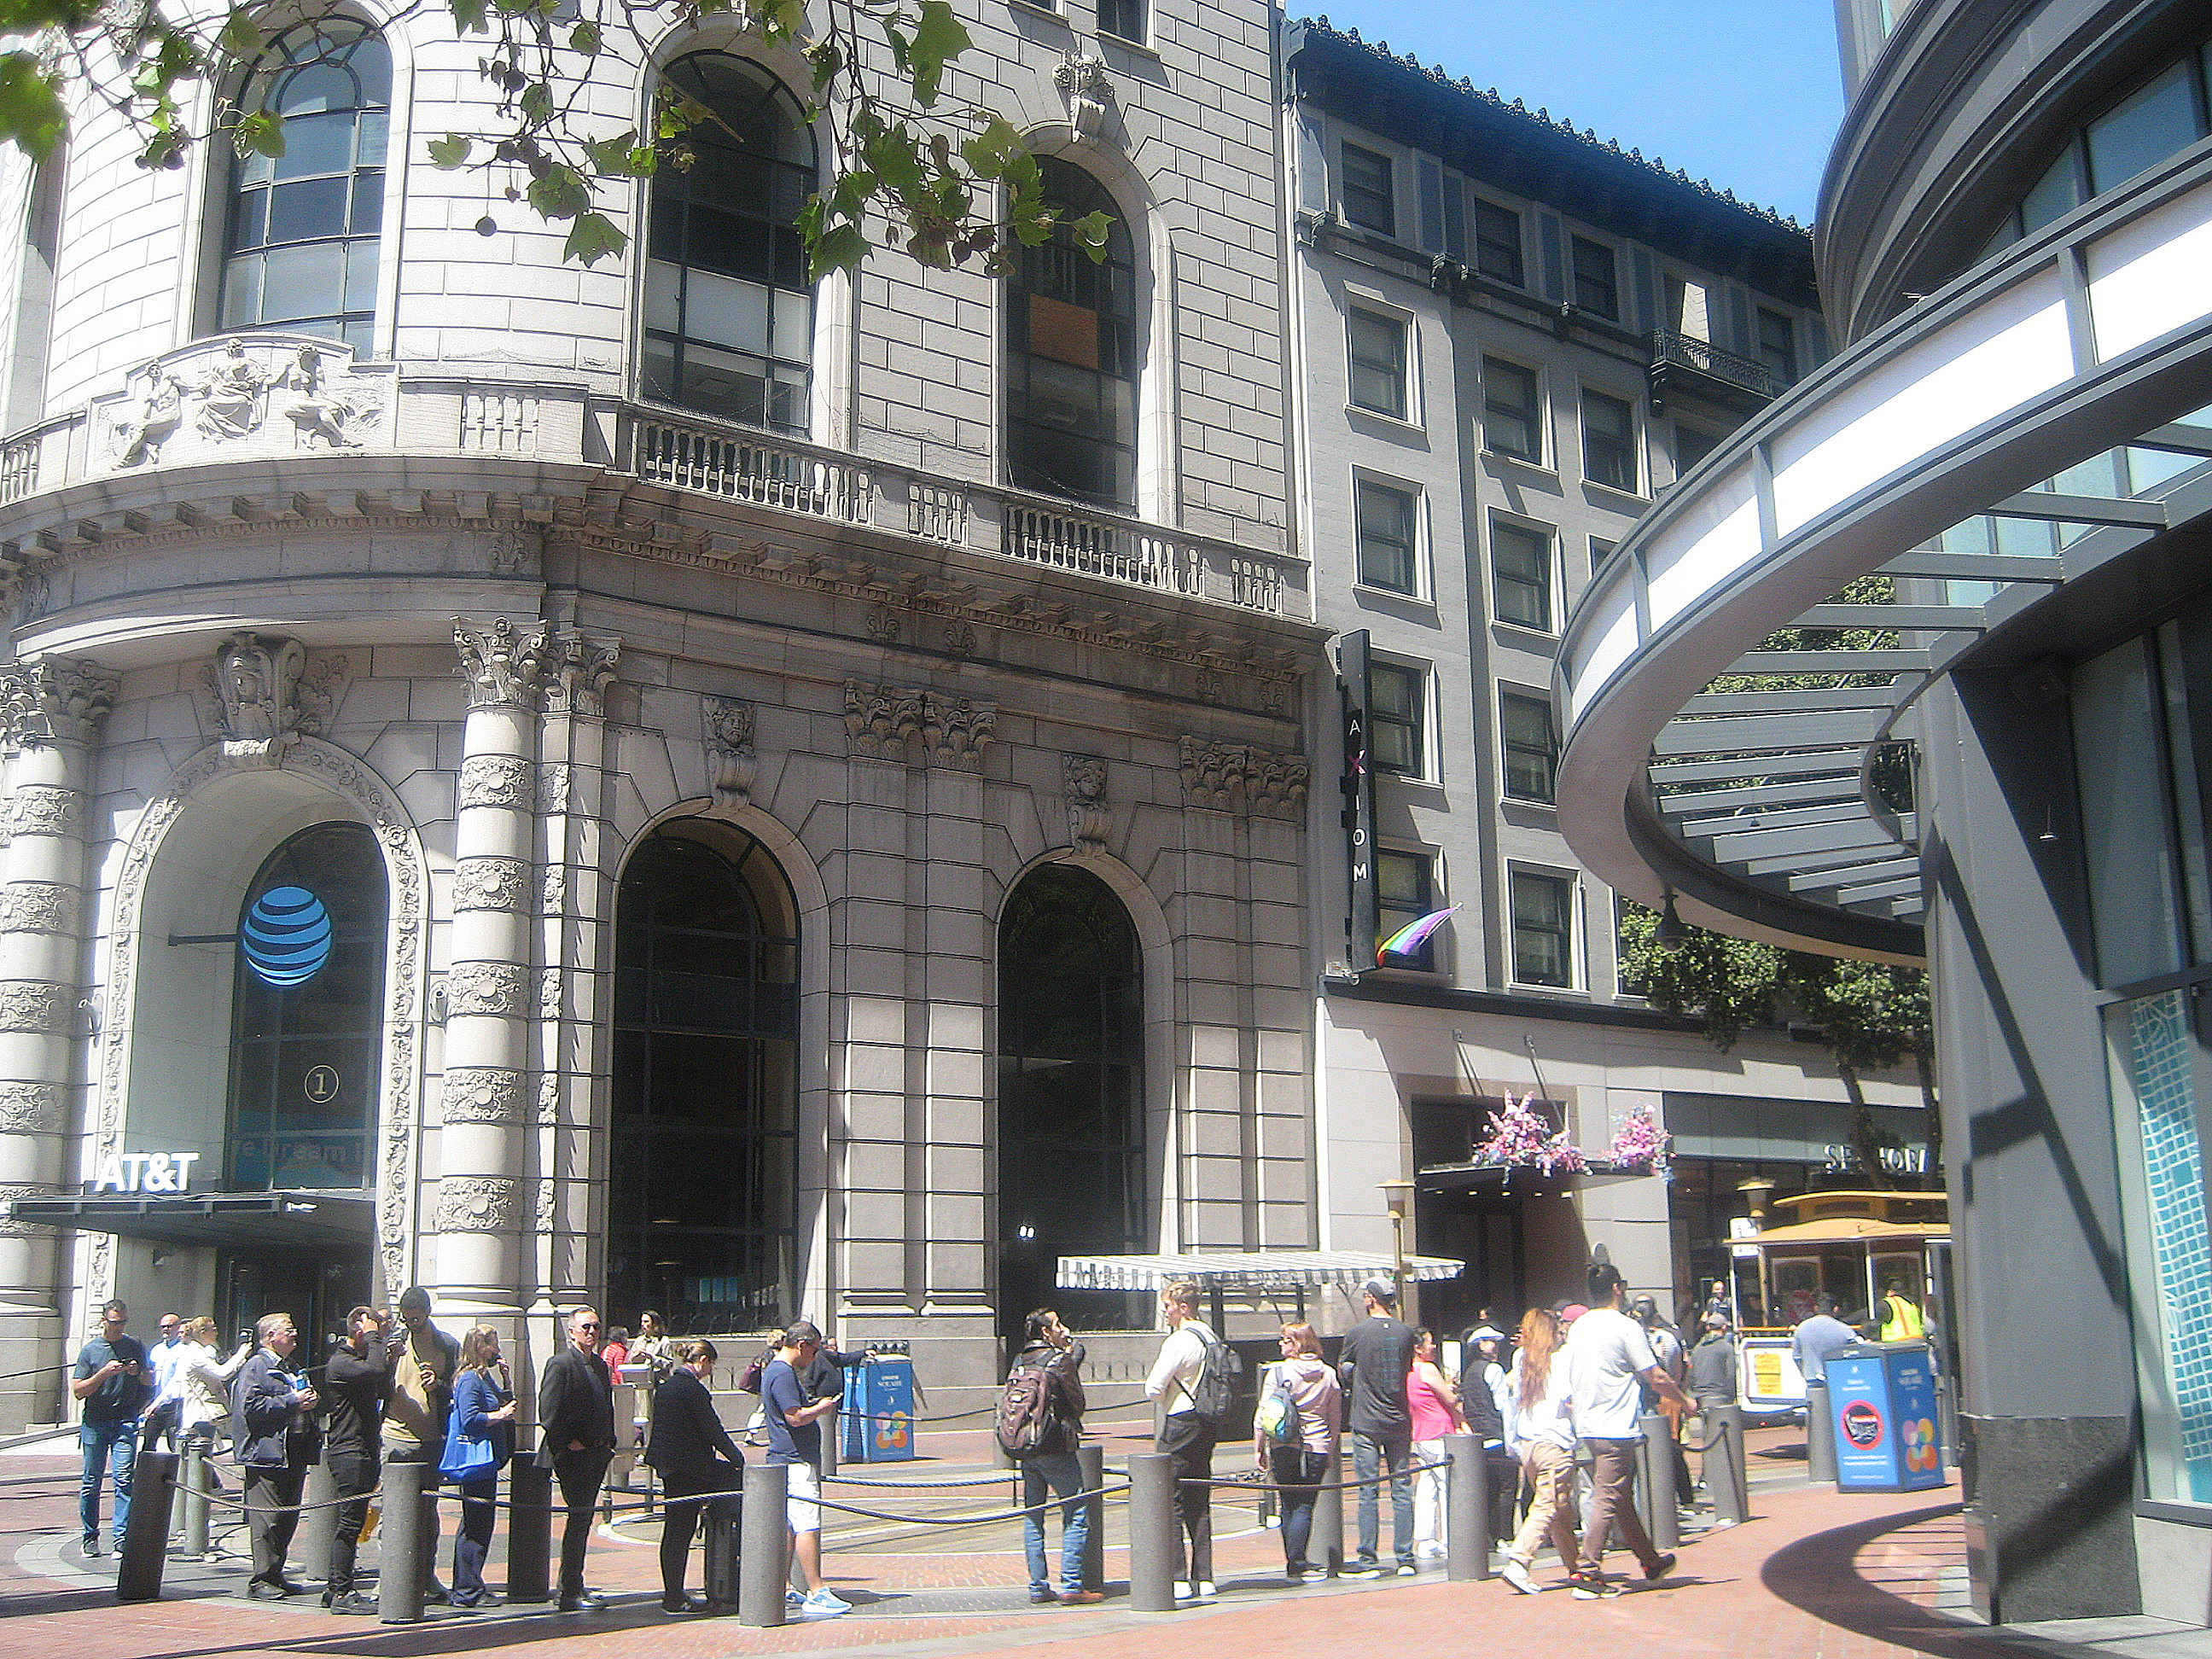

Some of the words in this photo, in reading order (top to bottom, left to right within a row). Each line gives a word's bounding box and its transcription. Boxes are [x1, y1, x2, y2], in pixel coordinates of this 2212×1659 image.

[1348, 719, 1369, 882] AXIOM
[315, 1074, 326, 1094] 1
[94, 1151, 201, 1192] AT&T
